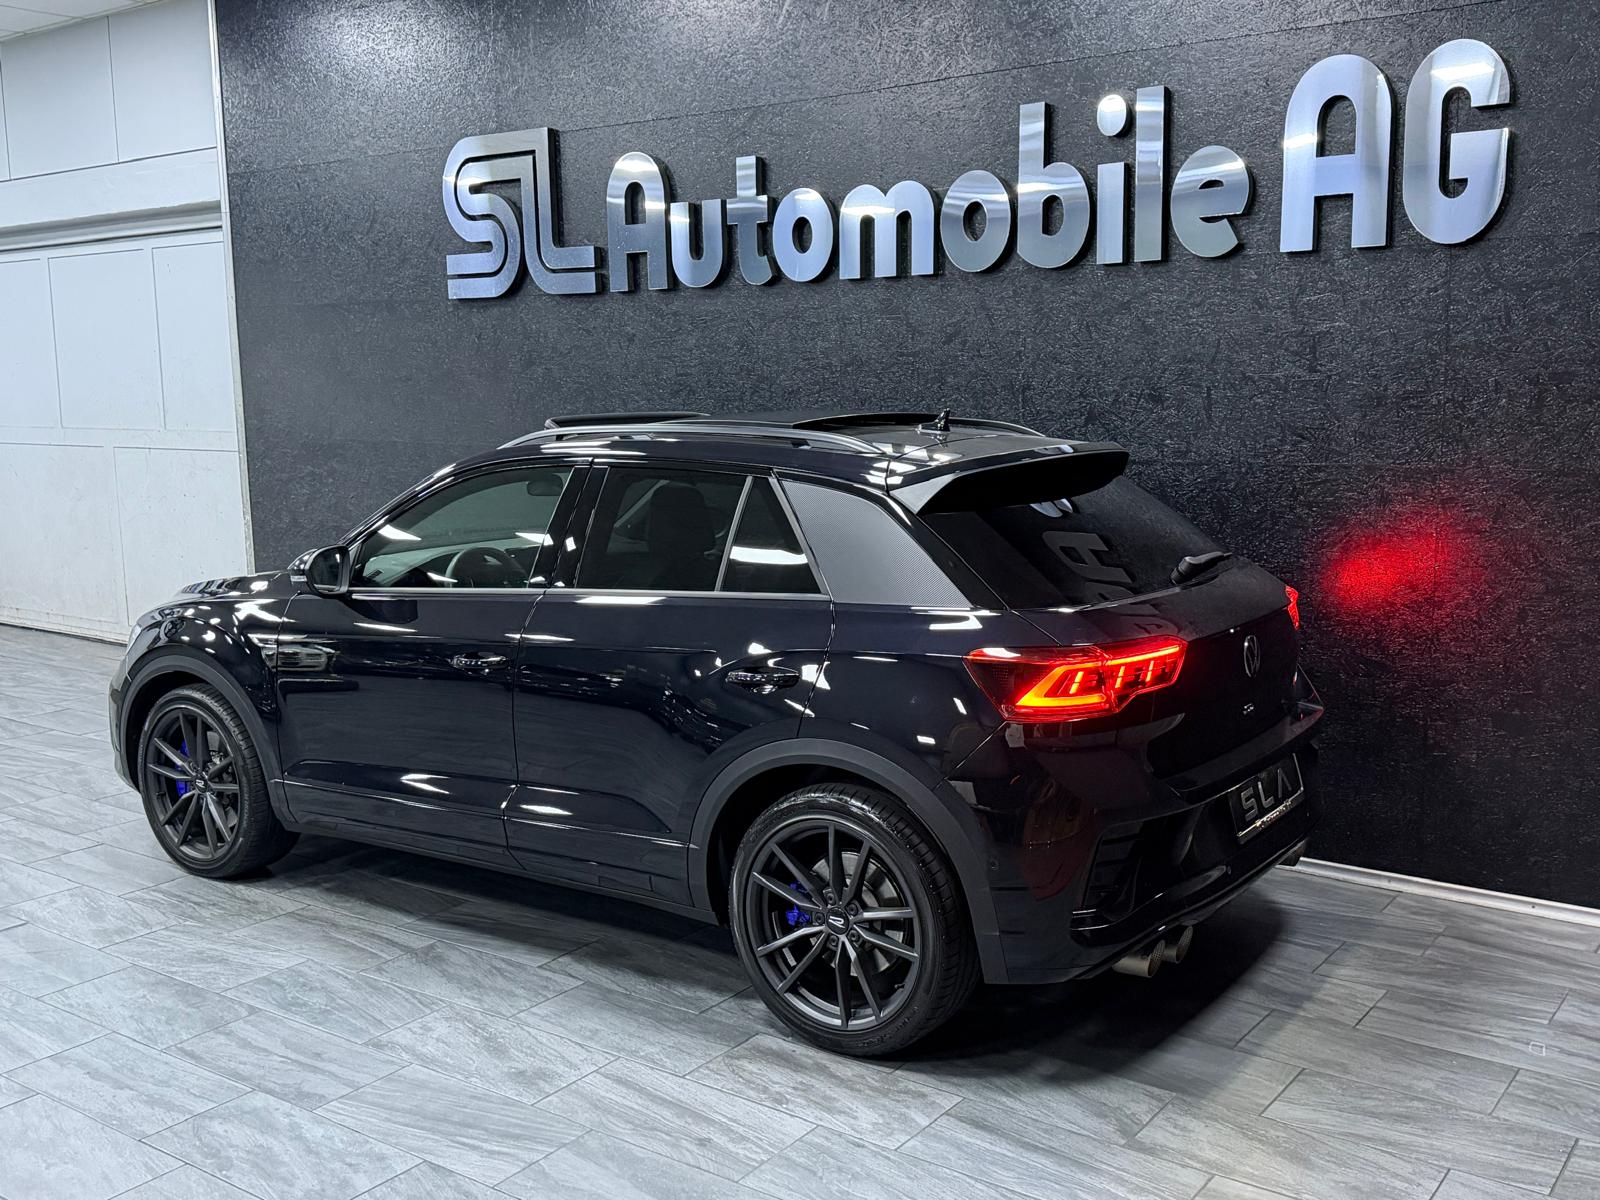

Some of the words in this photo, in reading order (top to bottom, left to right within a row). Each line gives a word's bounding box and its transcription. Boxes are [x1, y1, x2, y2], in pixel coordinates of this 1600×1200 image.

[443, 127, 596, 300] SL
[606, 86, 1250, 293] Automobile
[1280, 38, 1511, 253] AG
